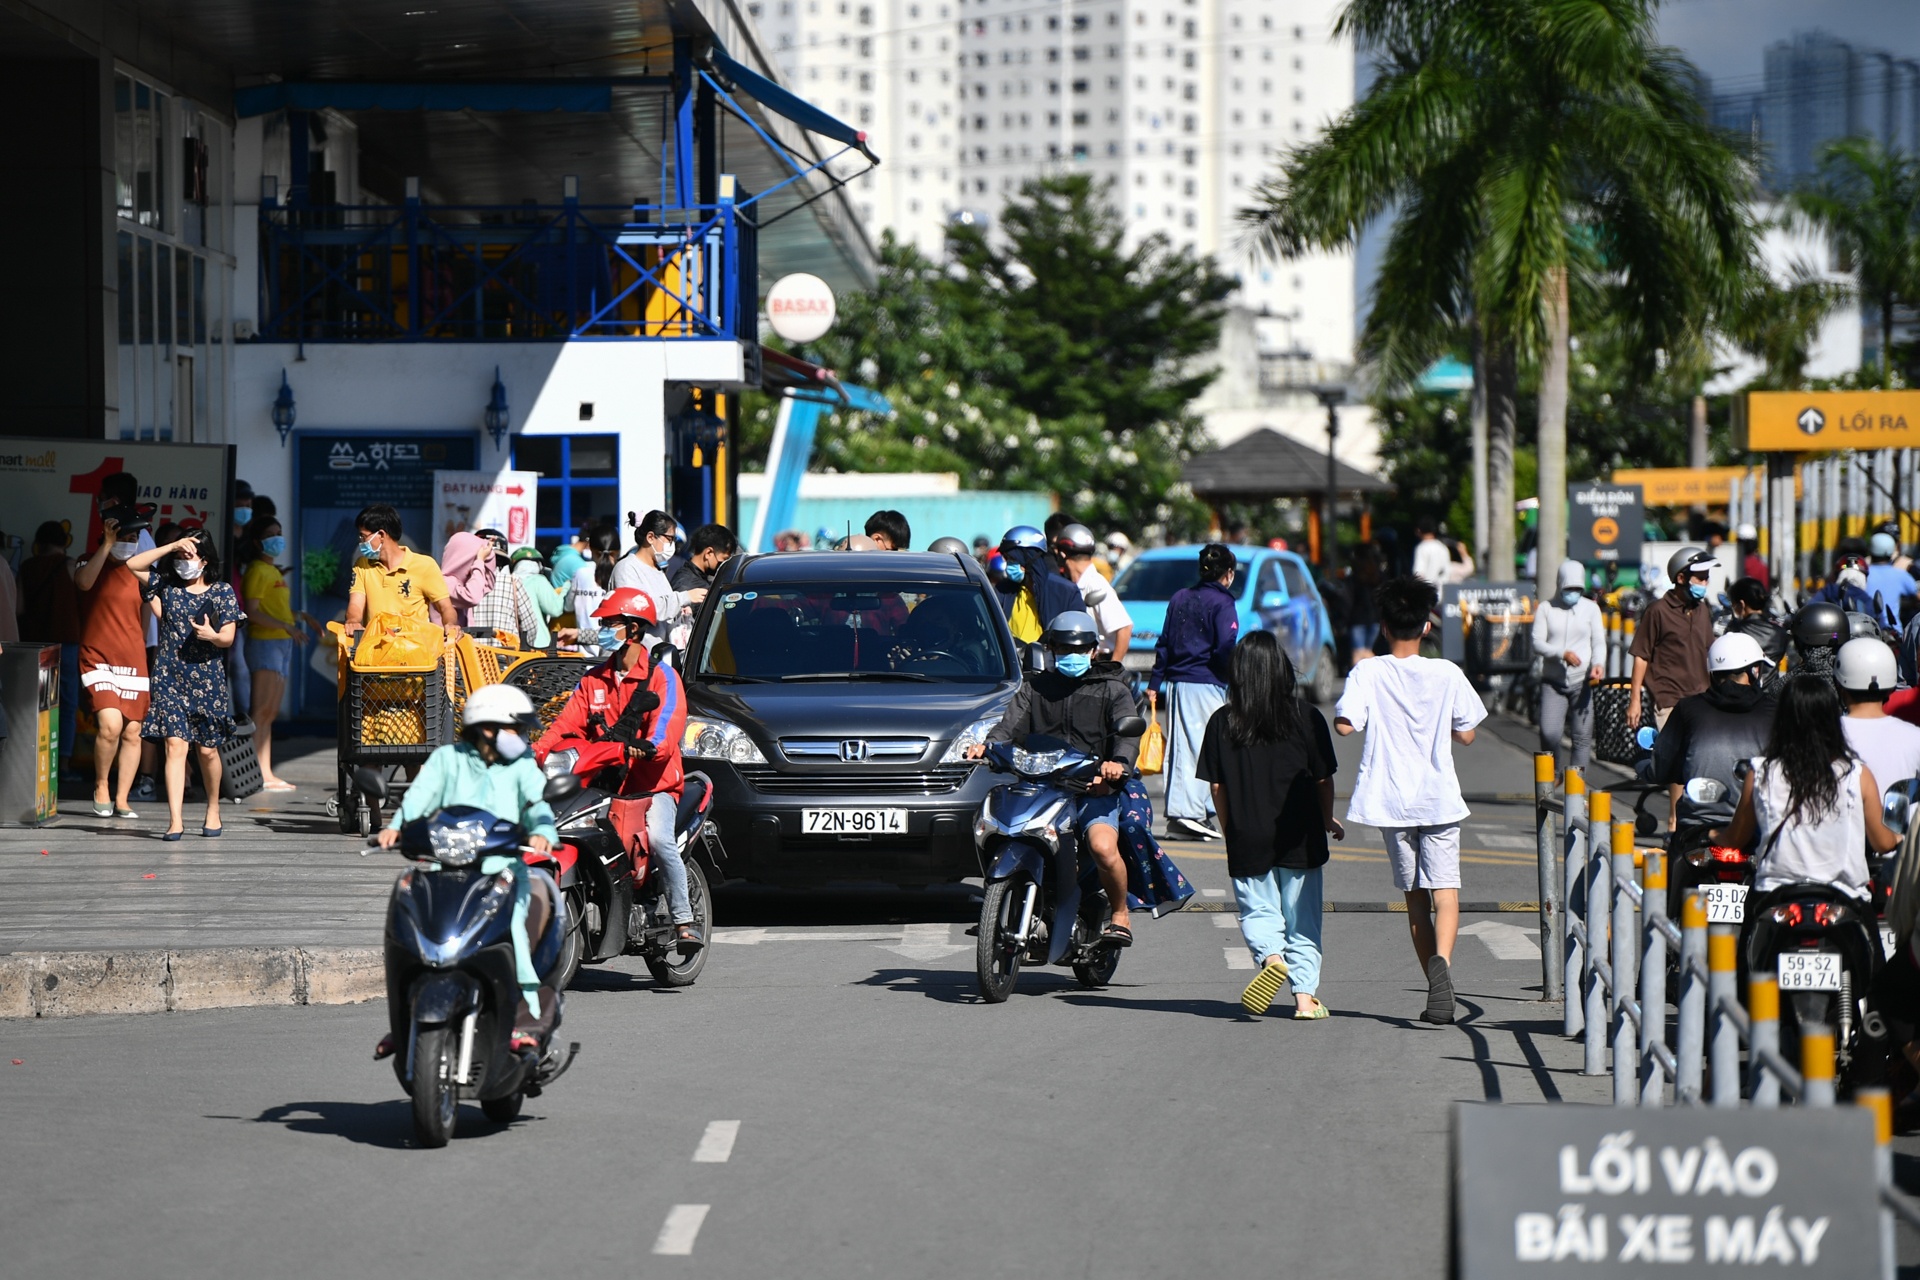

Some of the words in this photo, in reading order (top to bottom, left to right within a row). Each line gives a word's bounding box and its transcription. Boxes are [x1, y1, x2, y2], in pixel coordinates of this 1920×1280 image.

[1839, 407, 1873, 432] LỐI
[1879, 415, 1908, 430] RA
[25, 450, 56, 468] mall
[136, 485, 162, 499] IAO
[168, 483, 209, 500] HÀNG
[470, 480, 504, 494] HÀNG
[120, 689, 139, 701] EART
[808, 811, 900, 832] 72N-9614
[1711, 904, 1743, 920] 77.6
[1787, 956, 1832, 970] 59-S2
[1782, 971, 1838, 987] 689.74
[1558, 1130, 1651, 1196] LỐI
[1658, 1136, 1779, 1198] VÀO
[1514, 1203, 1608, 1264] BÃI
[1618, 1213, 1695, 1264] XE
[1704, 1204, 1831, 1267] MÁY
